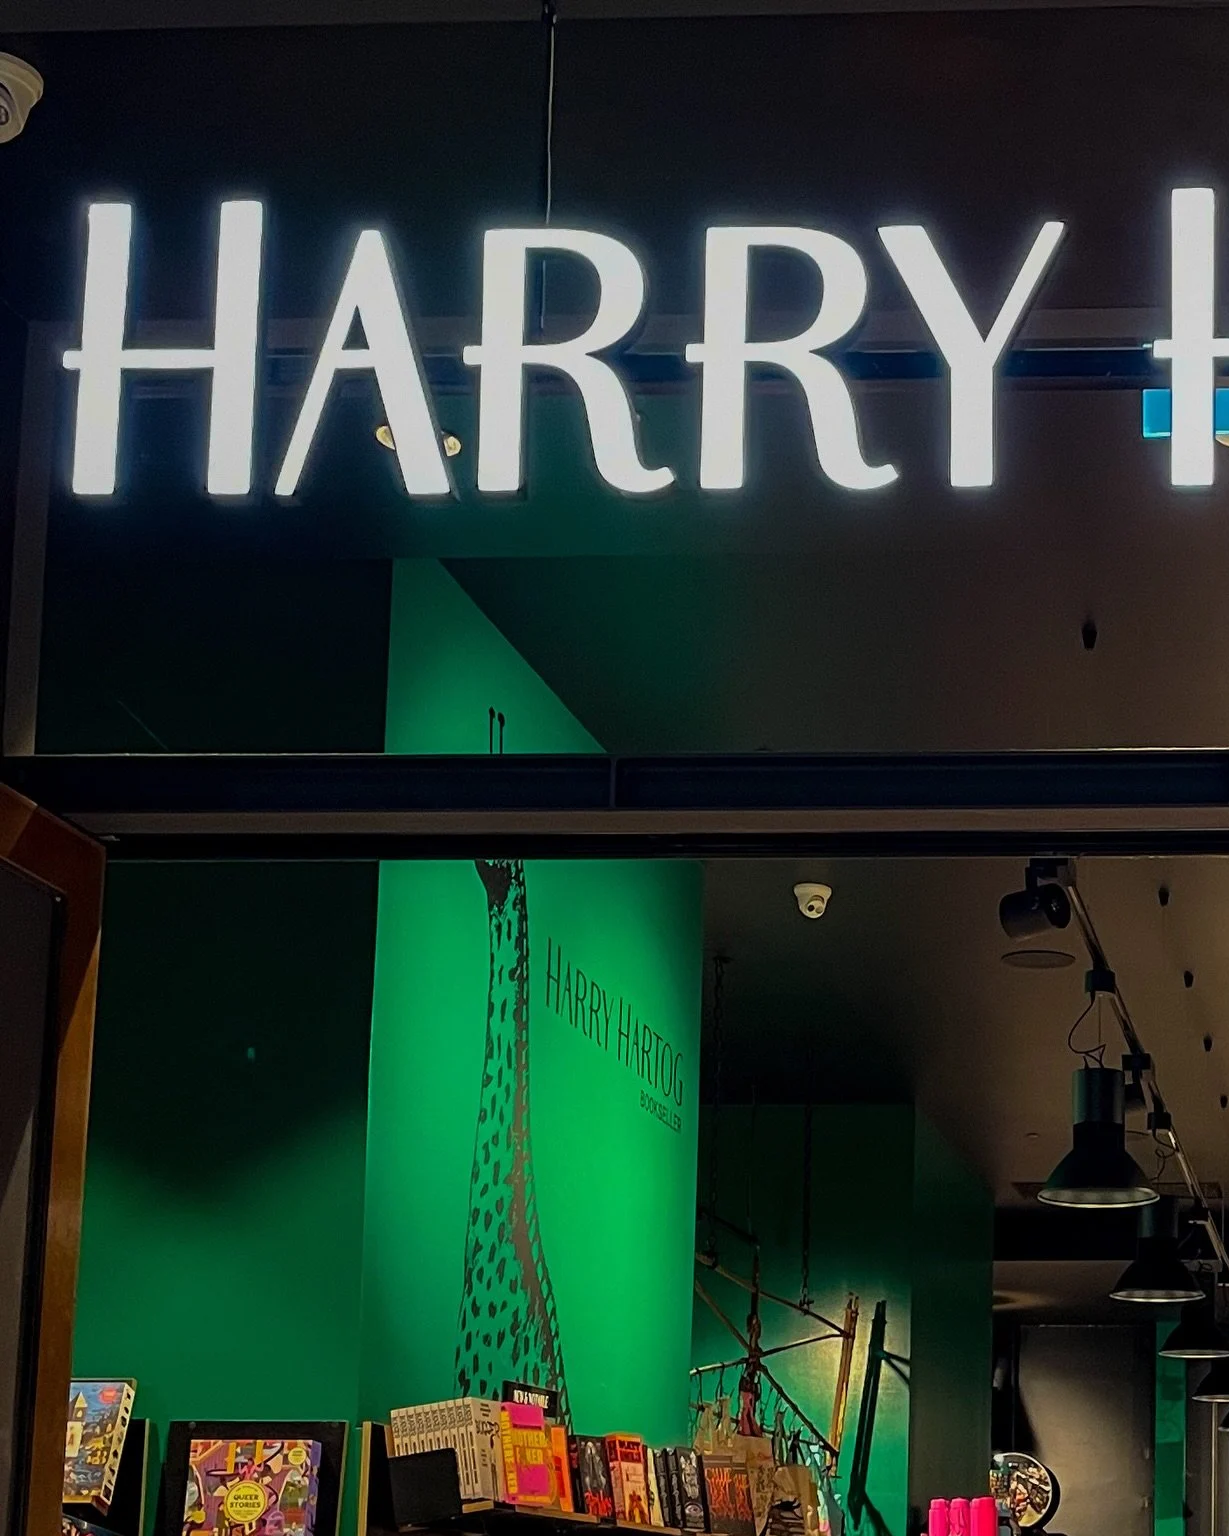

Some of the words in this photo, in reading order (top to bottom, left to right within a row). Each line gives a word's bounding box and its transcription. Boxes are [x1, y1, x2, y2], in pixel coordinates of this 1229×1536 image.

[62, 199, 1067, 498] HARRY
[546, 936, 614, 1051] HARRY
[618, 997, 683, 1106] HARTOG
[640, 1089, 682, 1130] BOOKSELLER
[229, 1501, 261, 1509] STORIES
